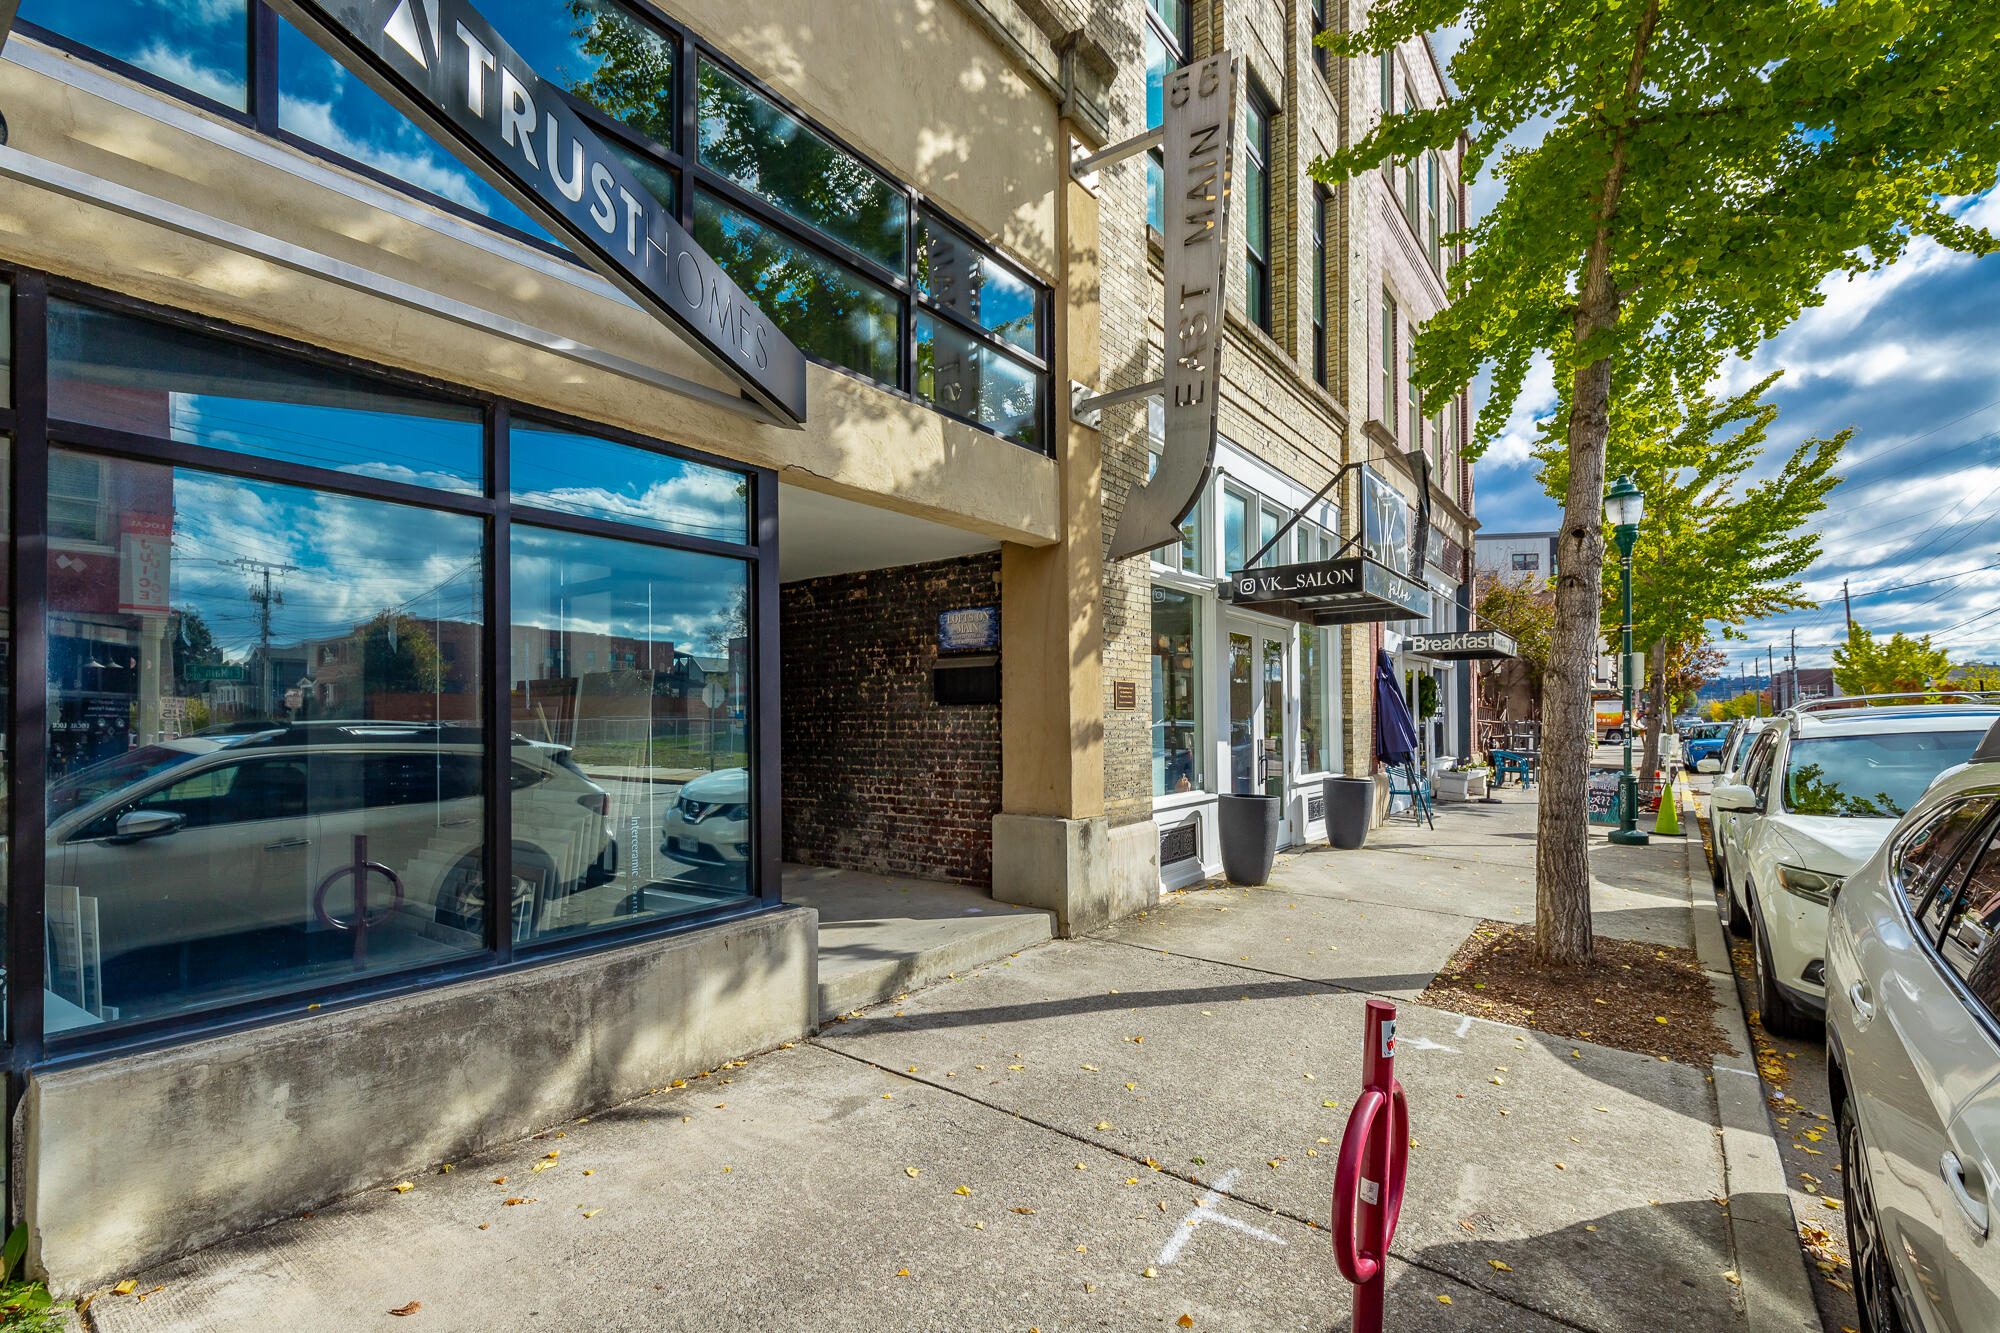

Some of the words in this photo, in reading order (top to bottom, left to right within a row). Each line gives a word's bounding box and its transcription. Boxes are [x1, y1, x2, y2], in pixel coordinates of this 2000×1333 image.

[1170, 61, 1220, 109] 55
[1183, 124, 1220, 247] MAIN
[1175, 284, 1211, 409] EAST
[947, 613, 974, 624] LOFTS
[976, 610, 989, 622] ON
[956, 623, 980, 634] MAIN
[1412, 631, 1495, 652] Breakfast
[1589, 804, 1608, 815] Day
[631, 816, 641, 876] Interceramic
